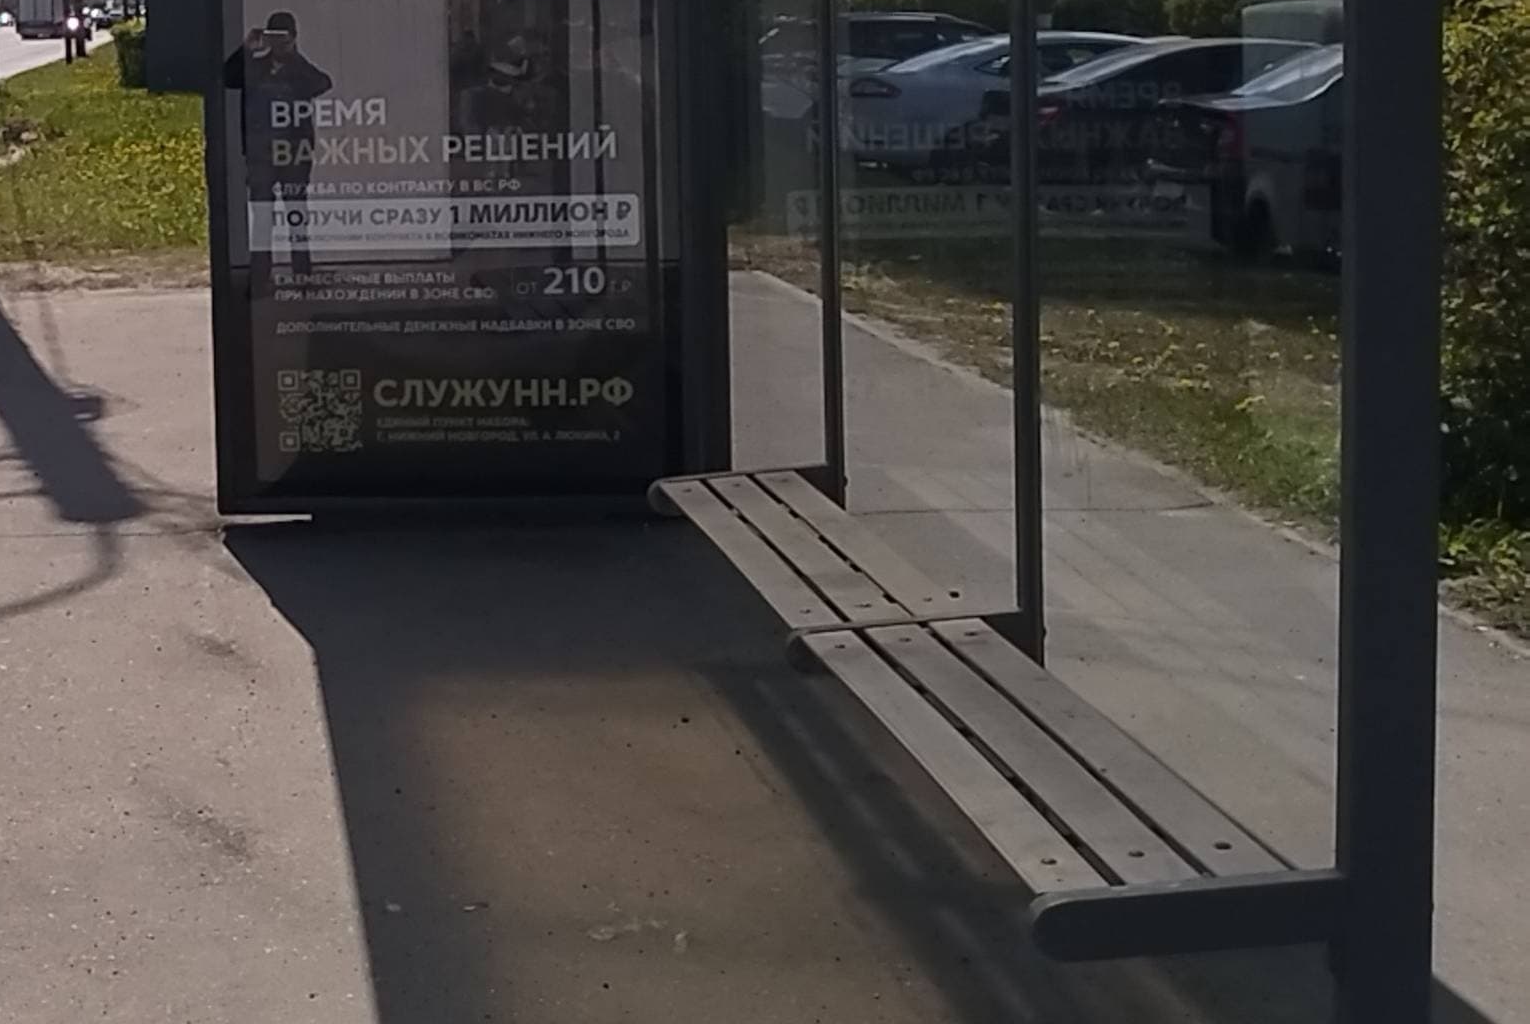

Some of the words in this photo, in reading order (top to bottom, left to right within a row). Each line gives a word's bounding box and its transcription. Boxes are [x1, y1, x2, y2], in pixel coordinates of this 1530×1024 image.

[271, 97, 387, 128] ВРЕМЯ
[271, 135, 430, 167] ВАЖНЫХ
[441, 123, 618, 163] РЕШЕНИЙ
[271, 181, 336, 196] СЛУЖБА
[340, 181, 364, 194] ПО
[366, 178, 455, 195] КОНТРАКТУ
[459, 178, 469, 192] В
[472, 178, 493, 192] ВС
[498, 177, 522, 191] РФ
[271, 208, 363, 228] ПОЛУЧИ
[369, 207, 442, 227] СРАЗУ
[449, 204, 459, 225] 1
[469, 202, 609, 225] МИЛЛИОН
[384, 271, 455, 284] ВЫПЛАТЫ
[542, 265, 606, 296] 210
[275, 288, 302, 301] ПРИ
[305, 287, 406, 302] НАХОЖДЕНИИ
[410, 287, 419, 299] В
[423, 287, 461, 300] ЗОНЕ
[276, 319, 401, 334] ДОПОЛНИТЕЛЬНЫЕ
[404, 319, 477, 334] ДЕНЕЖНЫЕ
[480, 318, 552, 333] НАДБАВКИ
[555, 318, 564, 330] В
[568, 318, 603, 330] ЗОНЕ
[606, 317, 636, 330] СВО
[373, 376, 635, 408] СЛУЖУНН.РФ
